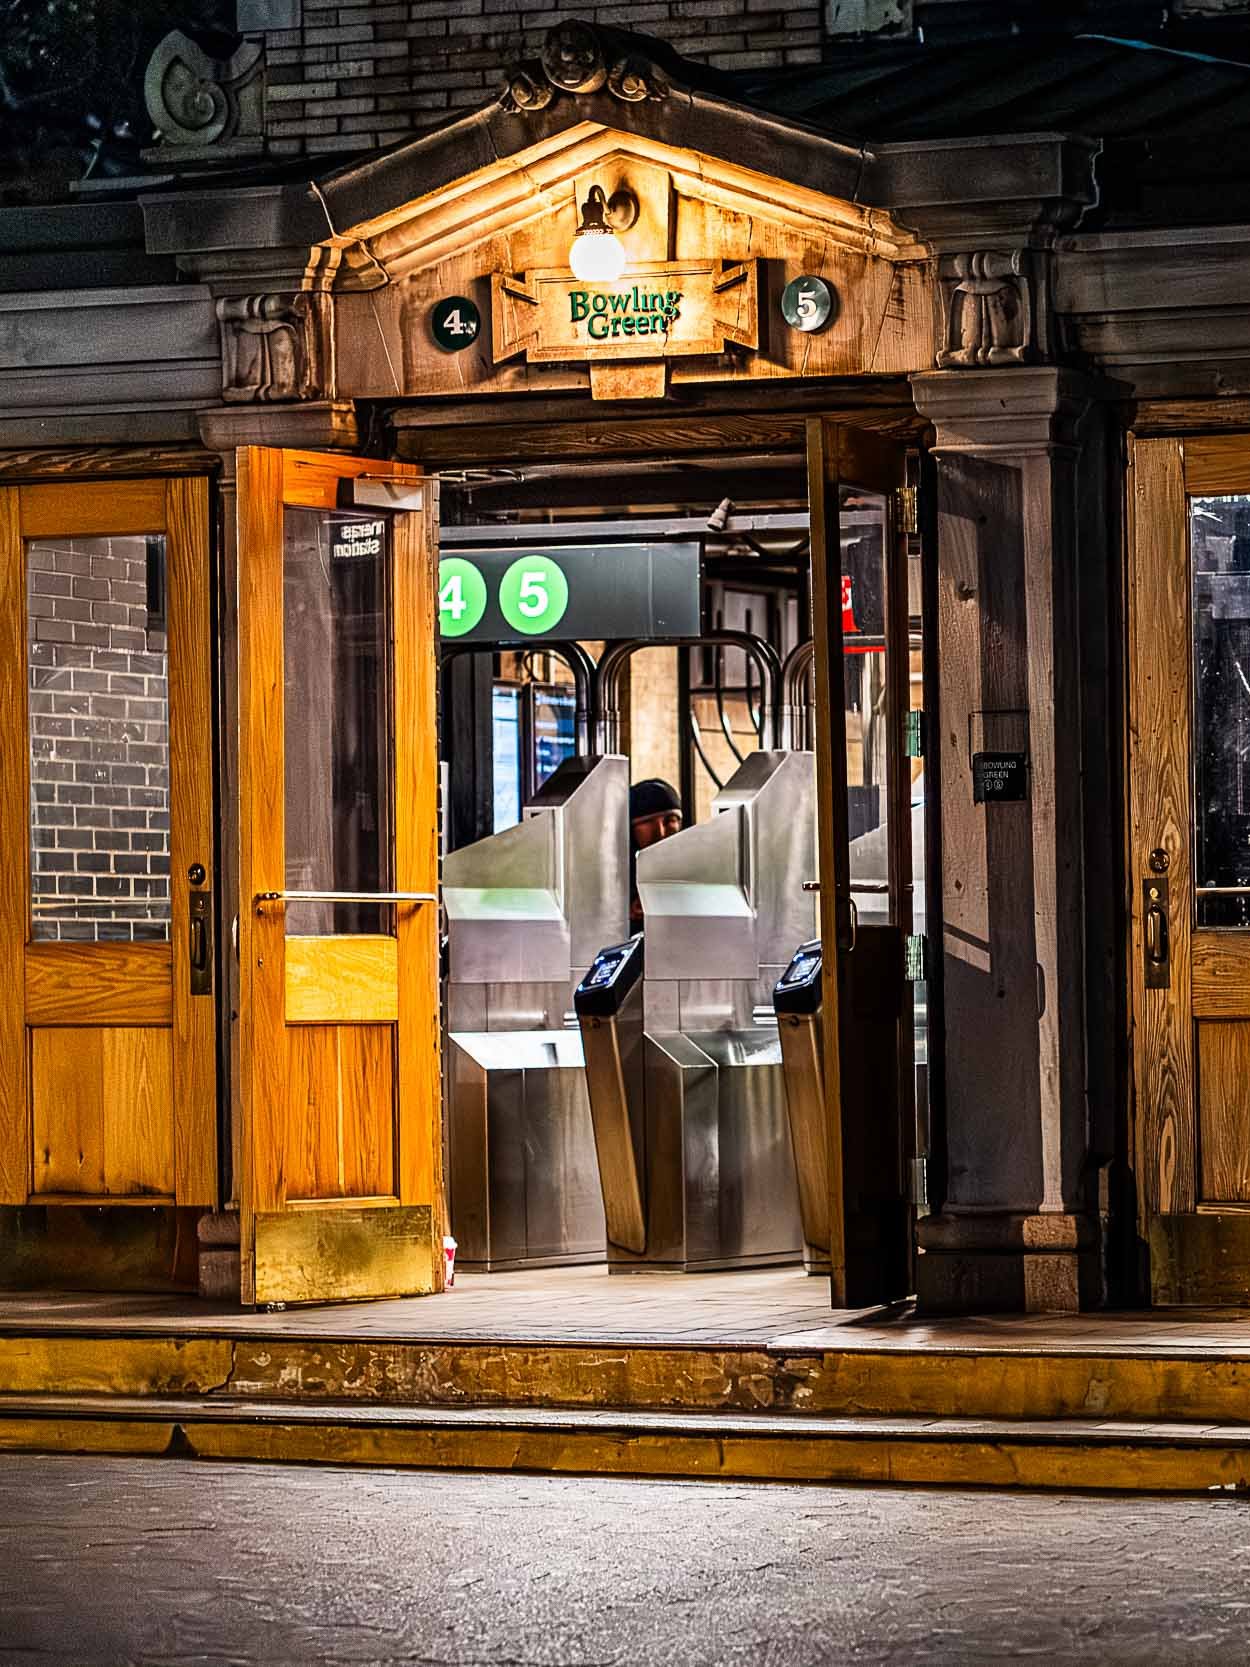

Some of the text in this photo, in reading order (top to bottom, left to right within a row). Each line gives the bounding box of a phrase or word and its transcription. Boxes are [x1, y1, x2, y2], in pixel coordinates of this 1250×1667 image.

[567, 285, 684, 322] Bowling
[797, 290, 817, 318] 5
[443, 309, 464, 335] 4
[588, 311, 669, 340] Green
[439, 571, 549, 620] 4 5
[983, 761, 1017, 770] BOWLING
[983, 770, 1009, 779] GREEN
